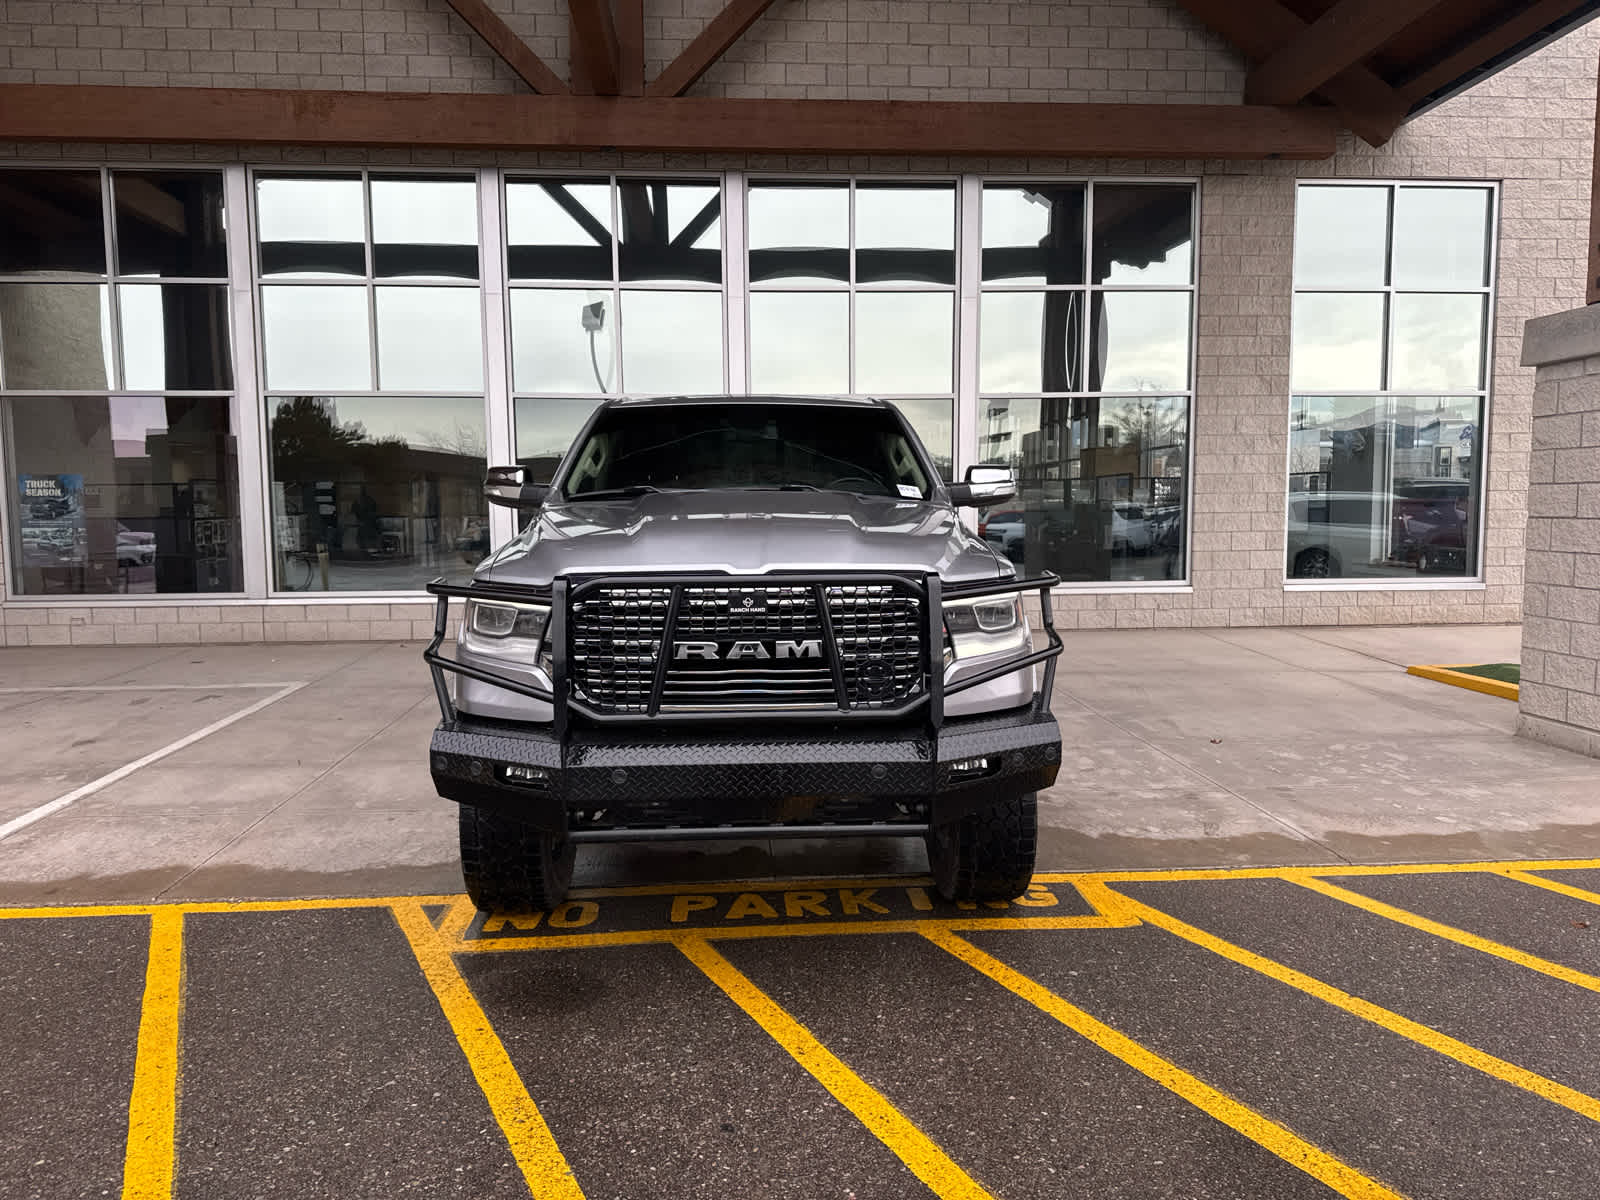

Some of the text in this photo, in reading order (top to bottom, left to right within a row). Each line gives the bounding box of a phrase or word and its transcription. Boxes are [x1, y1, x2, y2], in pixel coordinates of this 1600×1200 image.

[25, 480, 56, 488] TRUCK
[25, 488, 62, 497] SEASON
[673, 640, 822, 660] RAM
[482, 901, 600, 932] NO
